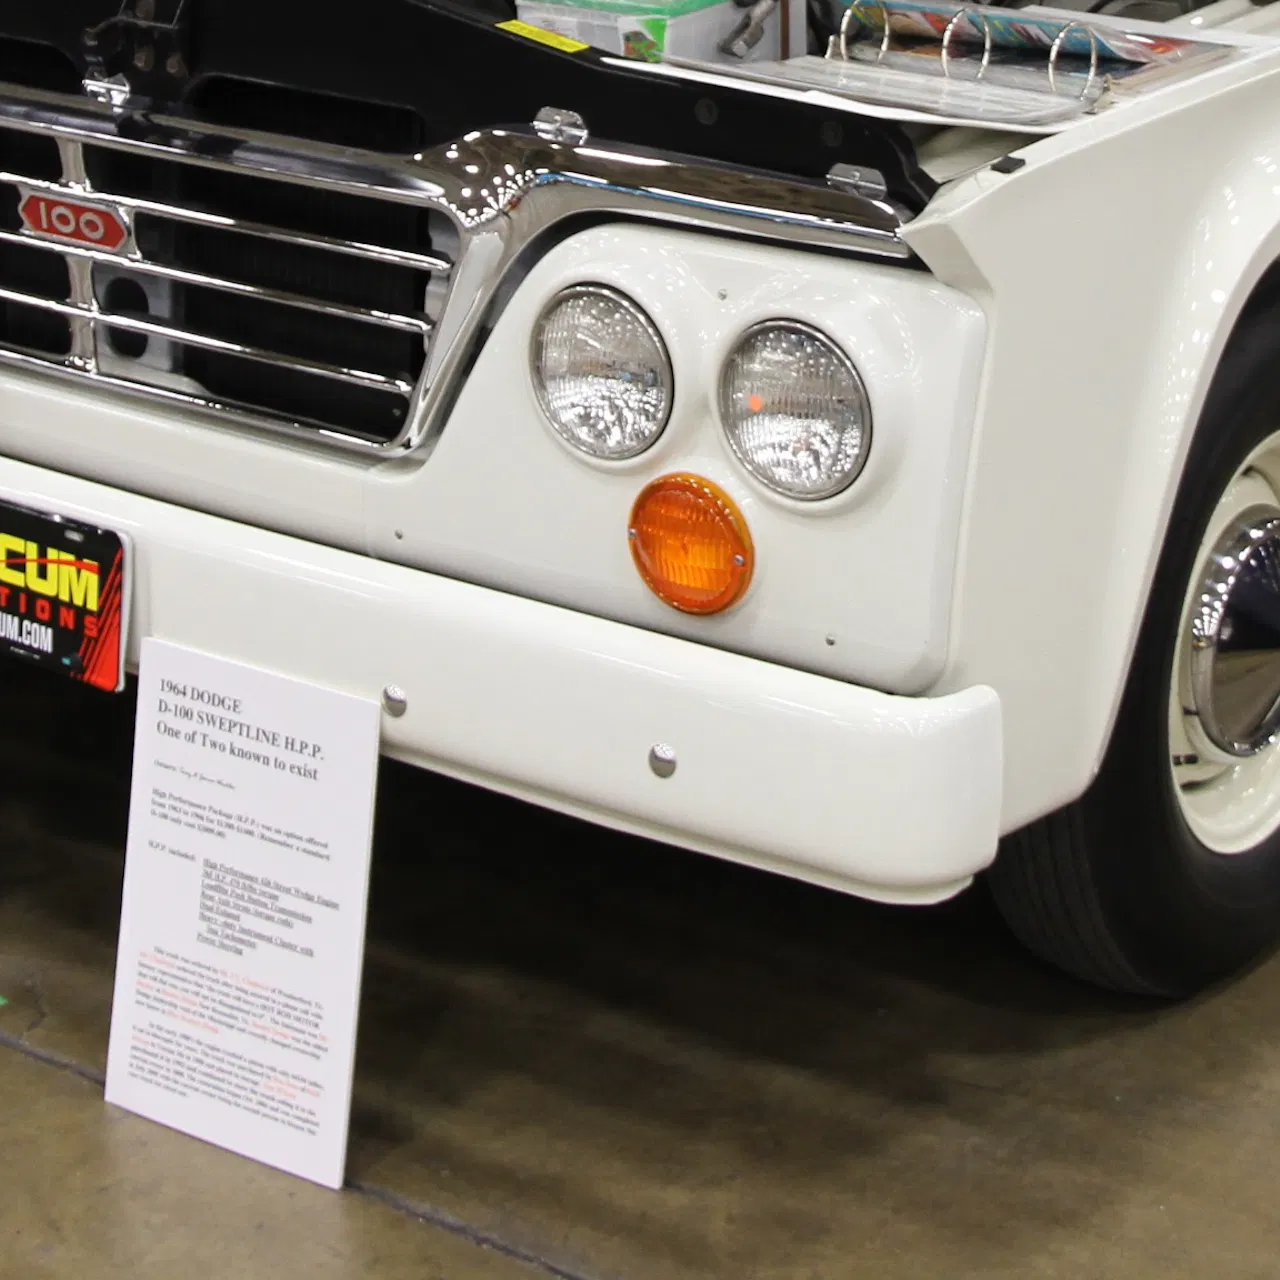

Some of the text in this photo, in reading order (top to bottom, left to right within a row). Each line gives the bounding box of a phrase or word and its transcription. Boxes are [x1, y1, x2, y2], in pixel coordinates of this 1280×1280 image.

[38, 200, 105, 240] 100
[158, 677, 243, 715] 1964 DODGE
[155, 718, 319, 781] One of Two known to exist
[157, 698, 325, 761] D-100 SWEPTLINE H.P.P.
[167, 792, 206, 812] Performance
